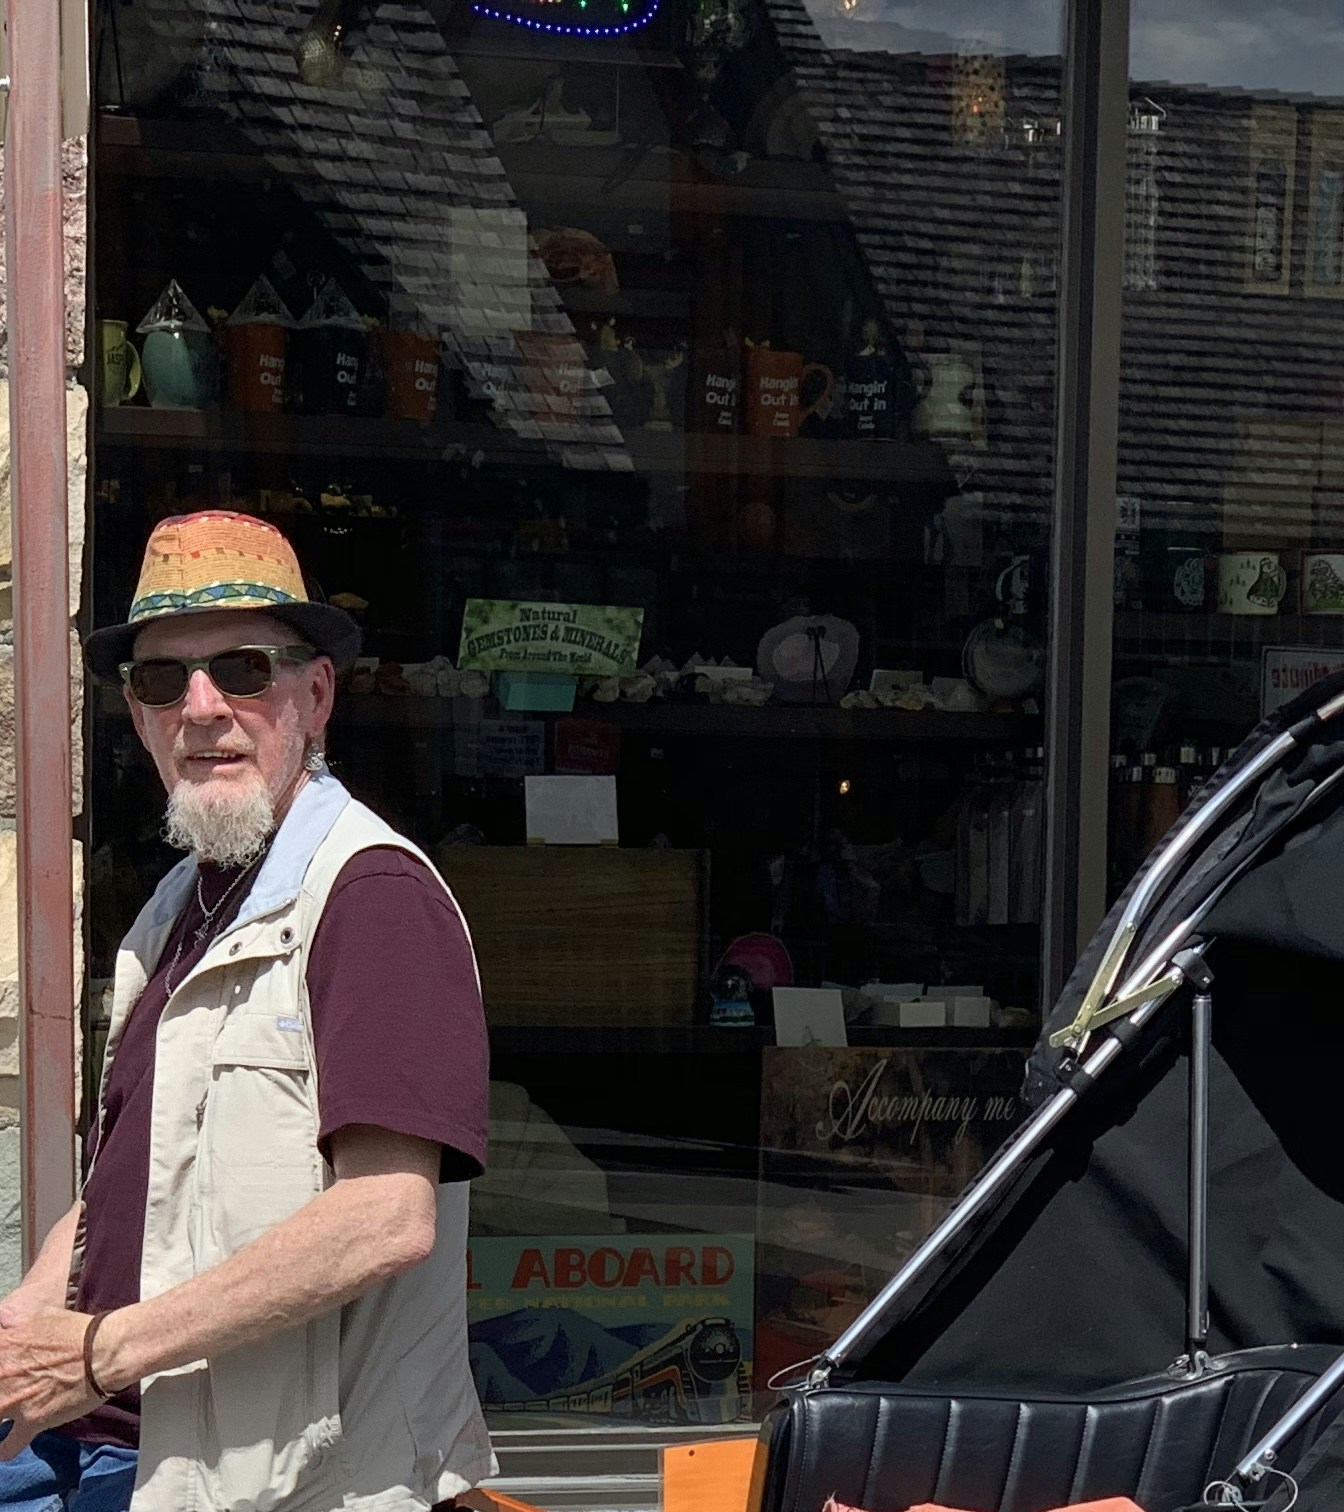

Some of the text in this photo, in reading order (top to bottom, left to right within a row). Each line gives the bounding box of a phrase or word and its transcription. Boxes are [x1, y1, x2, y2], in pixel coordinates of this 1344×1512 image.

[519, 607, 577, 623] Natural
[467, 624, 630, 664] GEMSTONES & MINERALS
[815, 1058, 978, 1146] Accompany
[510, 1246, 736, 1290] ABOARD
[524, 1294, 648, 1309] NATIONAL
[662, 1293, 731, 1307] PARK
